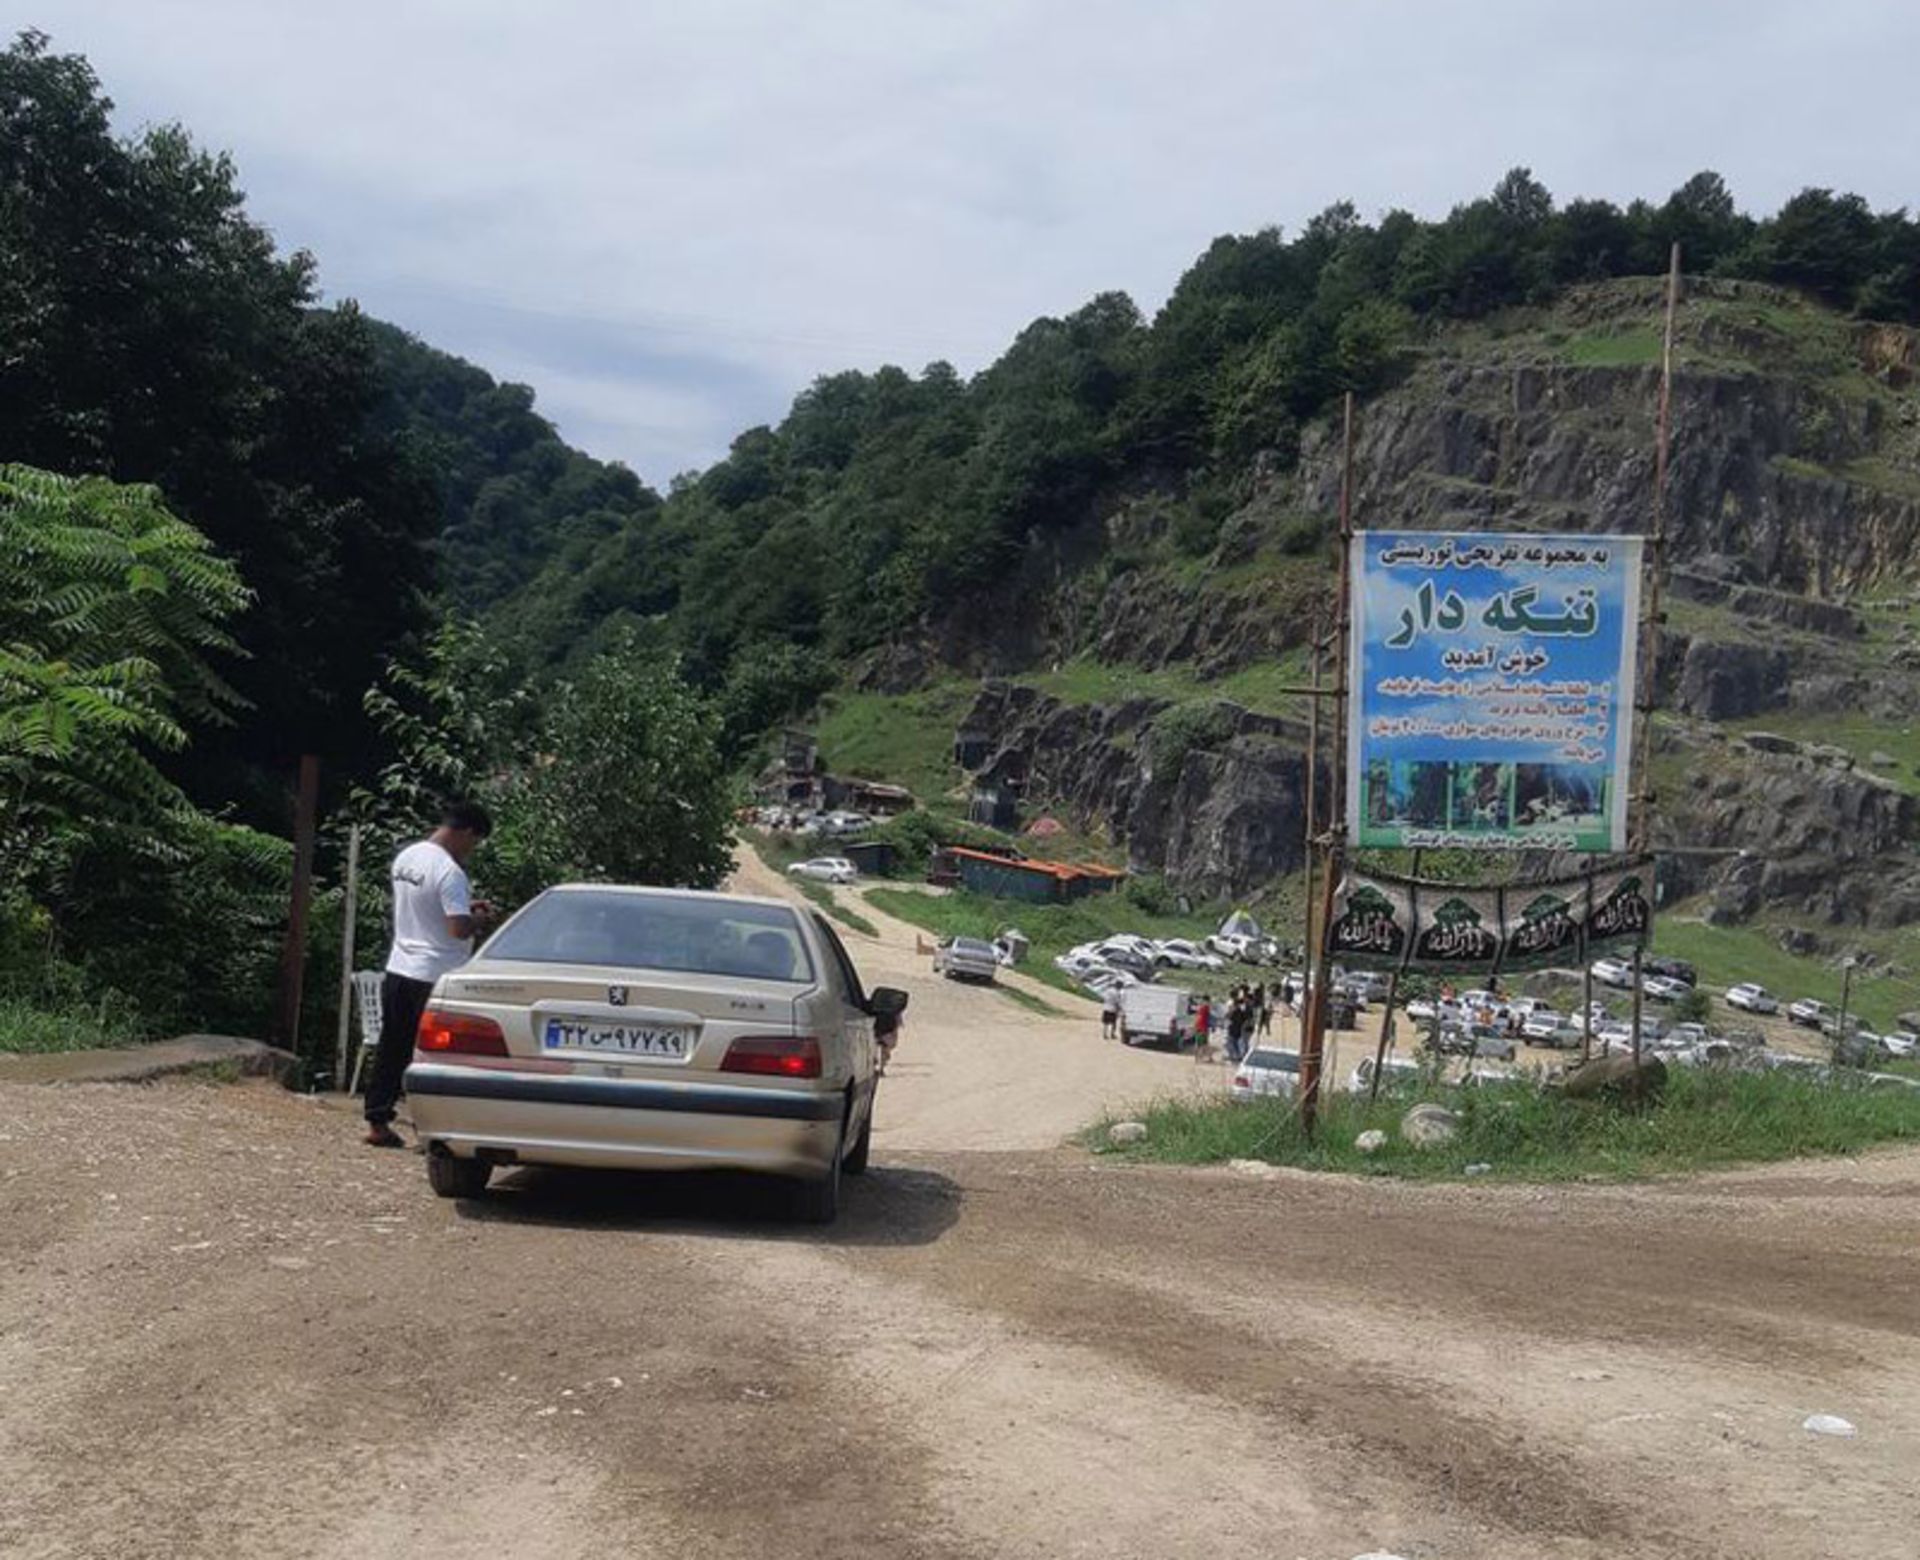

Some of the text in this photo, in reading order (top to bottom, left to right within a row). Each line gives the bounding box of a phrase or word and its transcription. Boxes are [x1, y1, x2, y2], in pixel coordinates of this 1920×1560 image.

[1379, 540, 1609, 571] به مجموعه تفریحی توریستی
[1386, 580, 1597, 647] تنگه دار
[1443, 644, 1547, 674] خوش آمدید
